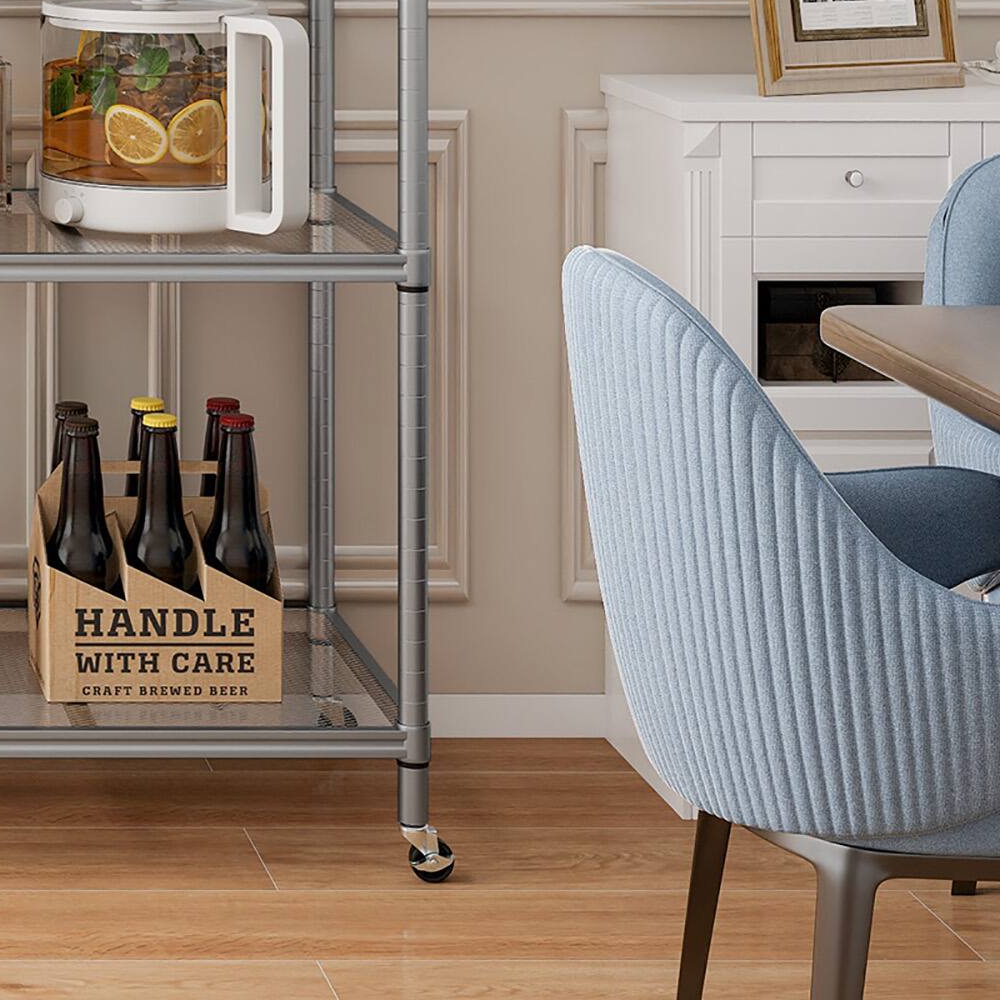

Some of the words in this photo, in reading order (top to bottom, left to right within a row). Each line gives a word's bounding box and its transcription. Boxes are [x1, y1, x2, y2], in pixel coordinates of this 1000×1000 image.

[74, 608, 255, 637] HANDLE
[75, 652, 160, 673] WITH
[171, 652, 255, 673] CARE
[82, 686, 133, 696] CRAFT
[139, 686, 203, 696] BREWED
[209, 686, 249, 696] BEER
